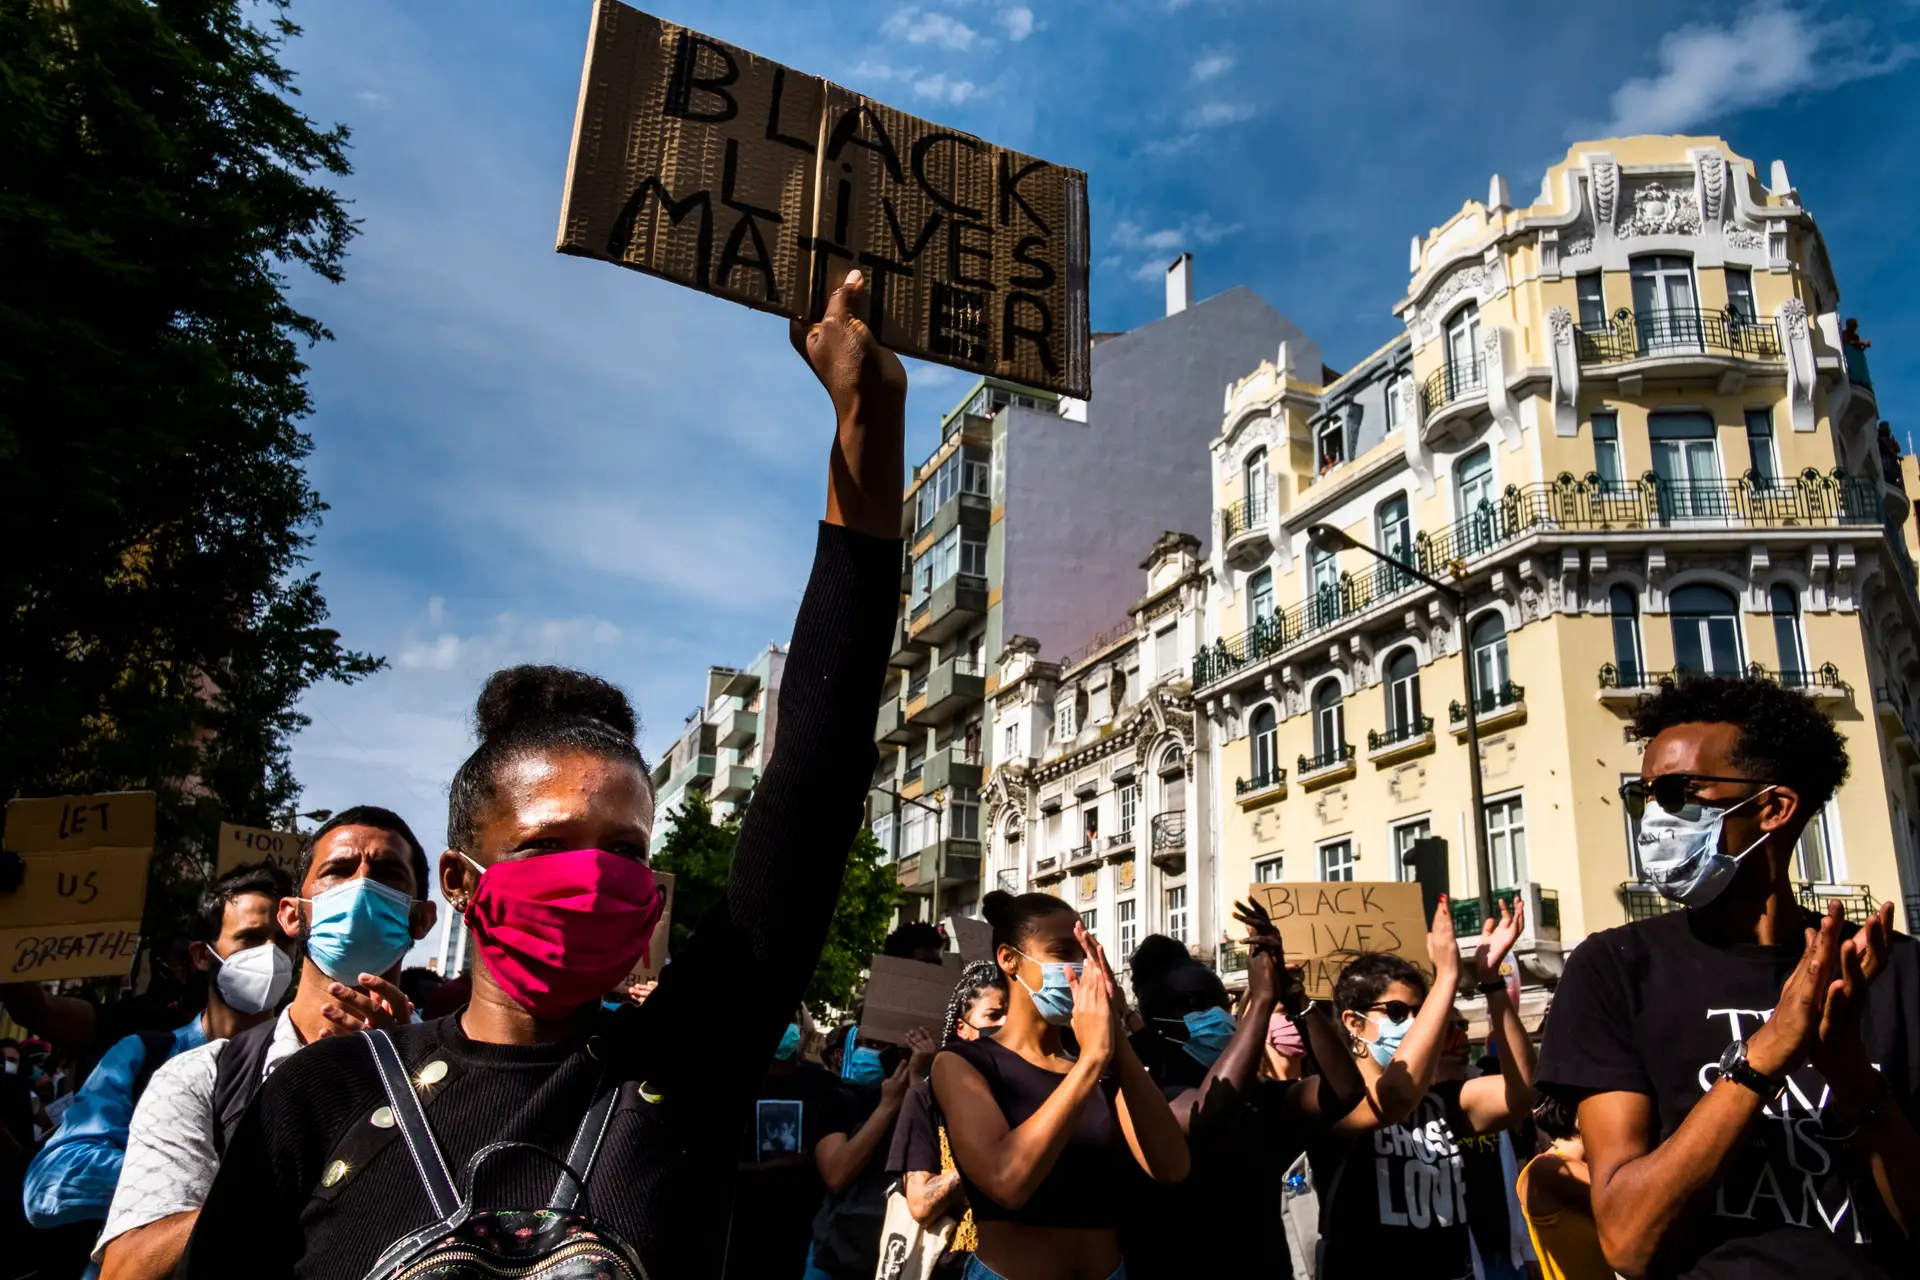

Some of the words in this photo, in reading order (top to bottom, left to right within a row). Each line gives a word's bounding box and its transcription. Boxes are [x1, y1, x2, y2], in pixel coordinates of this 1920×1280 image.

[662, 28, 1052, 237] BLACK
[606, 176, 1060, 376] MATTER
[58, 803, 110, 839] LET
[234, 831, 283, 852] 400
[57, 870, 98, 905] US
[1261, 886, 1385, 921] BLACK
[11, 930, 141, 973] BREATHE
[1283, 921, 1402, 955] IVES
